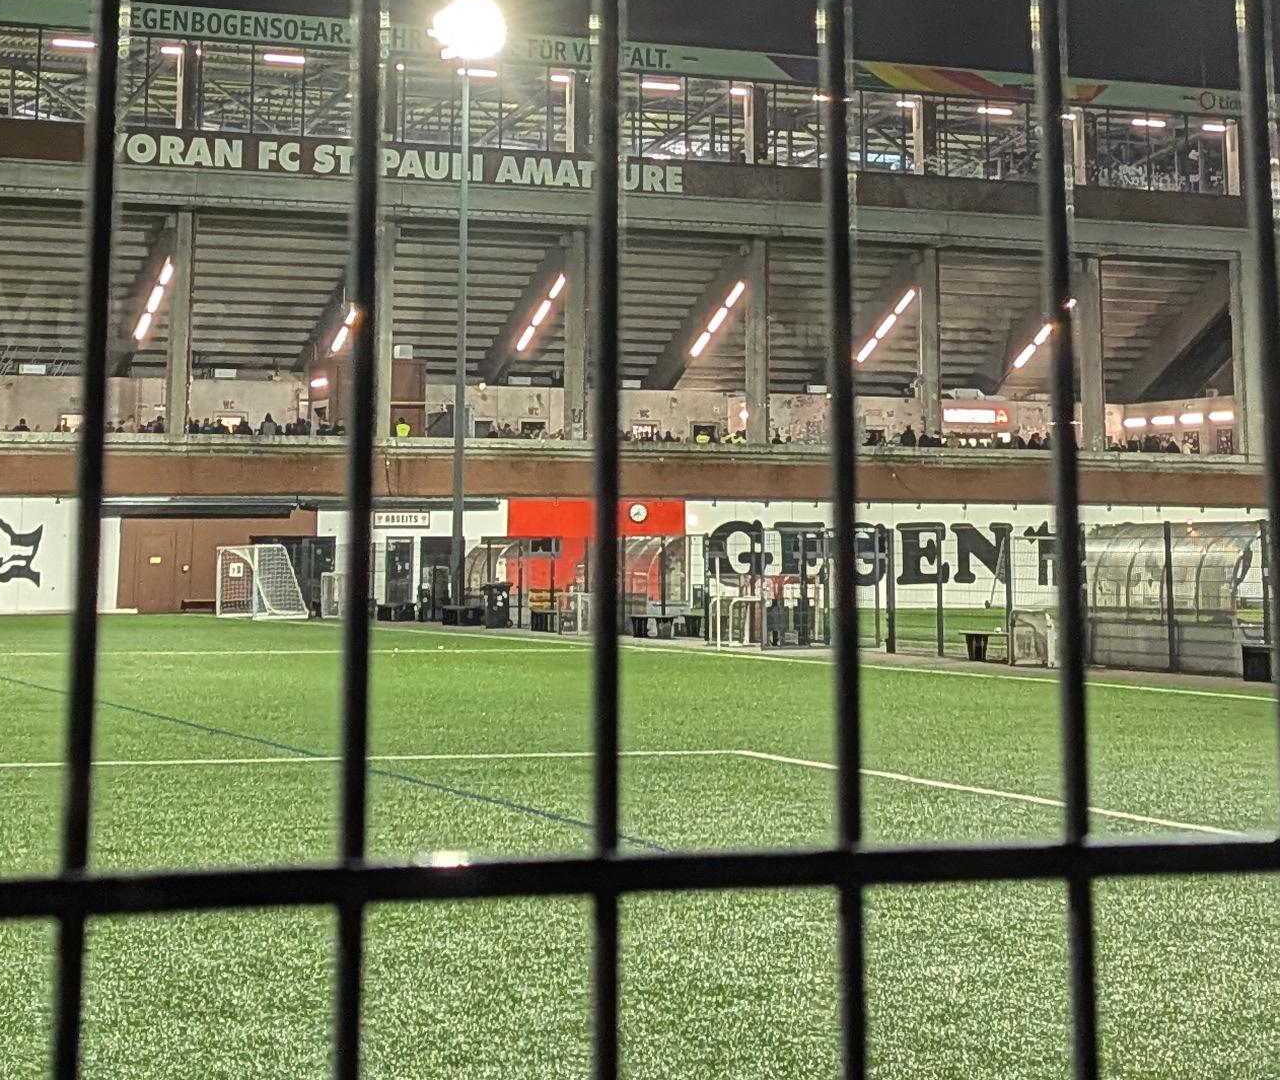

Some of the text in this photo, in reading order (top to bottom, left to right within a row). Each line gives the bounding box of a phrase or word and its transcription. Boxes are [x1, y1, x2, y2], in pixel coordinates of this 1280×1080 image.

[128, 6, 352, 45] EGENBOGENSOLAR.
[527, 38, 566, 62] FÜR
[573, 41, 672, 69] VIFALT.
[258, 140, 300, 172] FC
[379, 147, 484, 182] PAULI
[495, 154, 683, 193] AMATURE
[223, 400, 235, 410] WC
[385, 514, 419, 523] ABSEITS
[703, 519, 1013, 587] GEGEN
